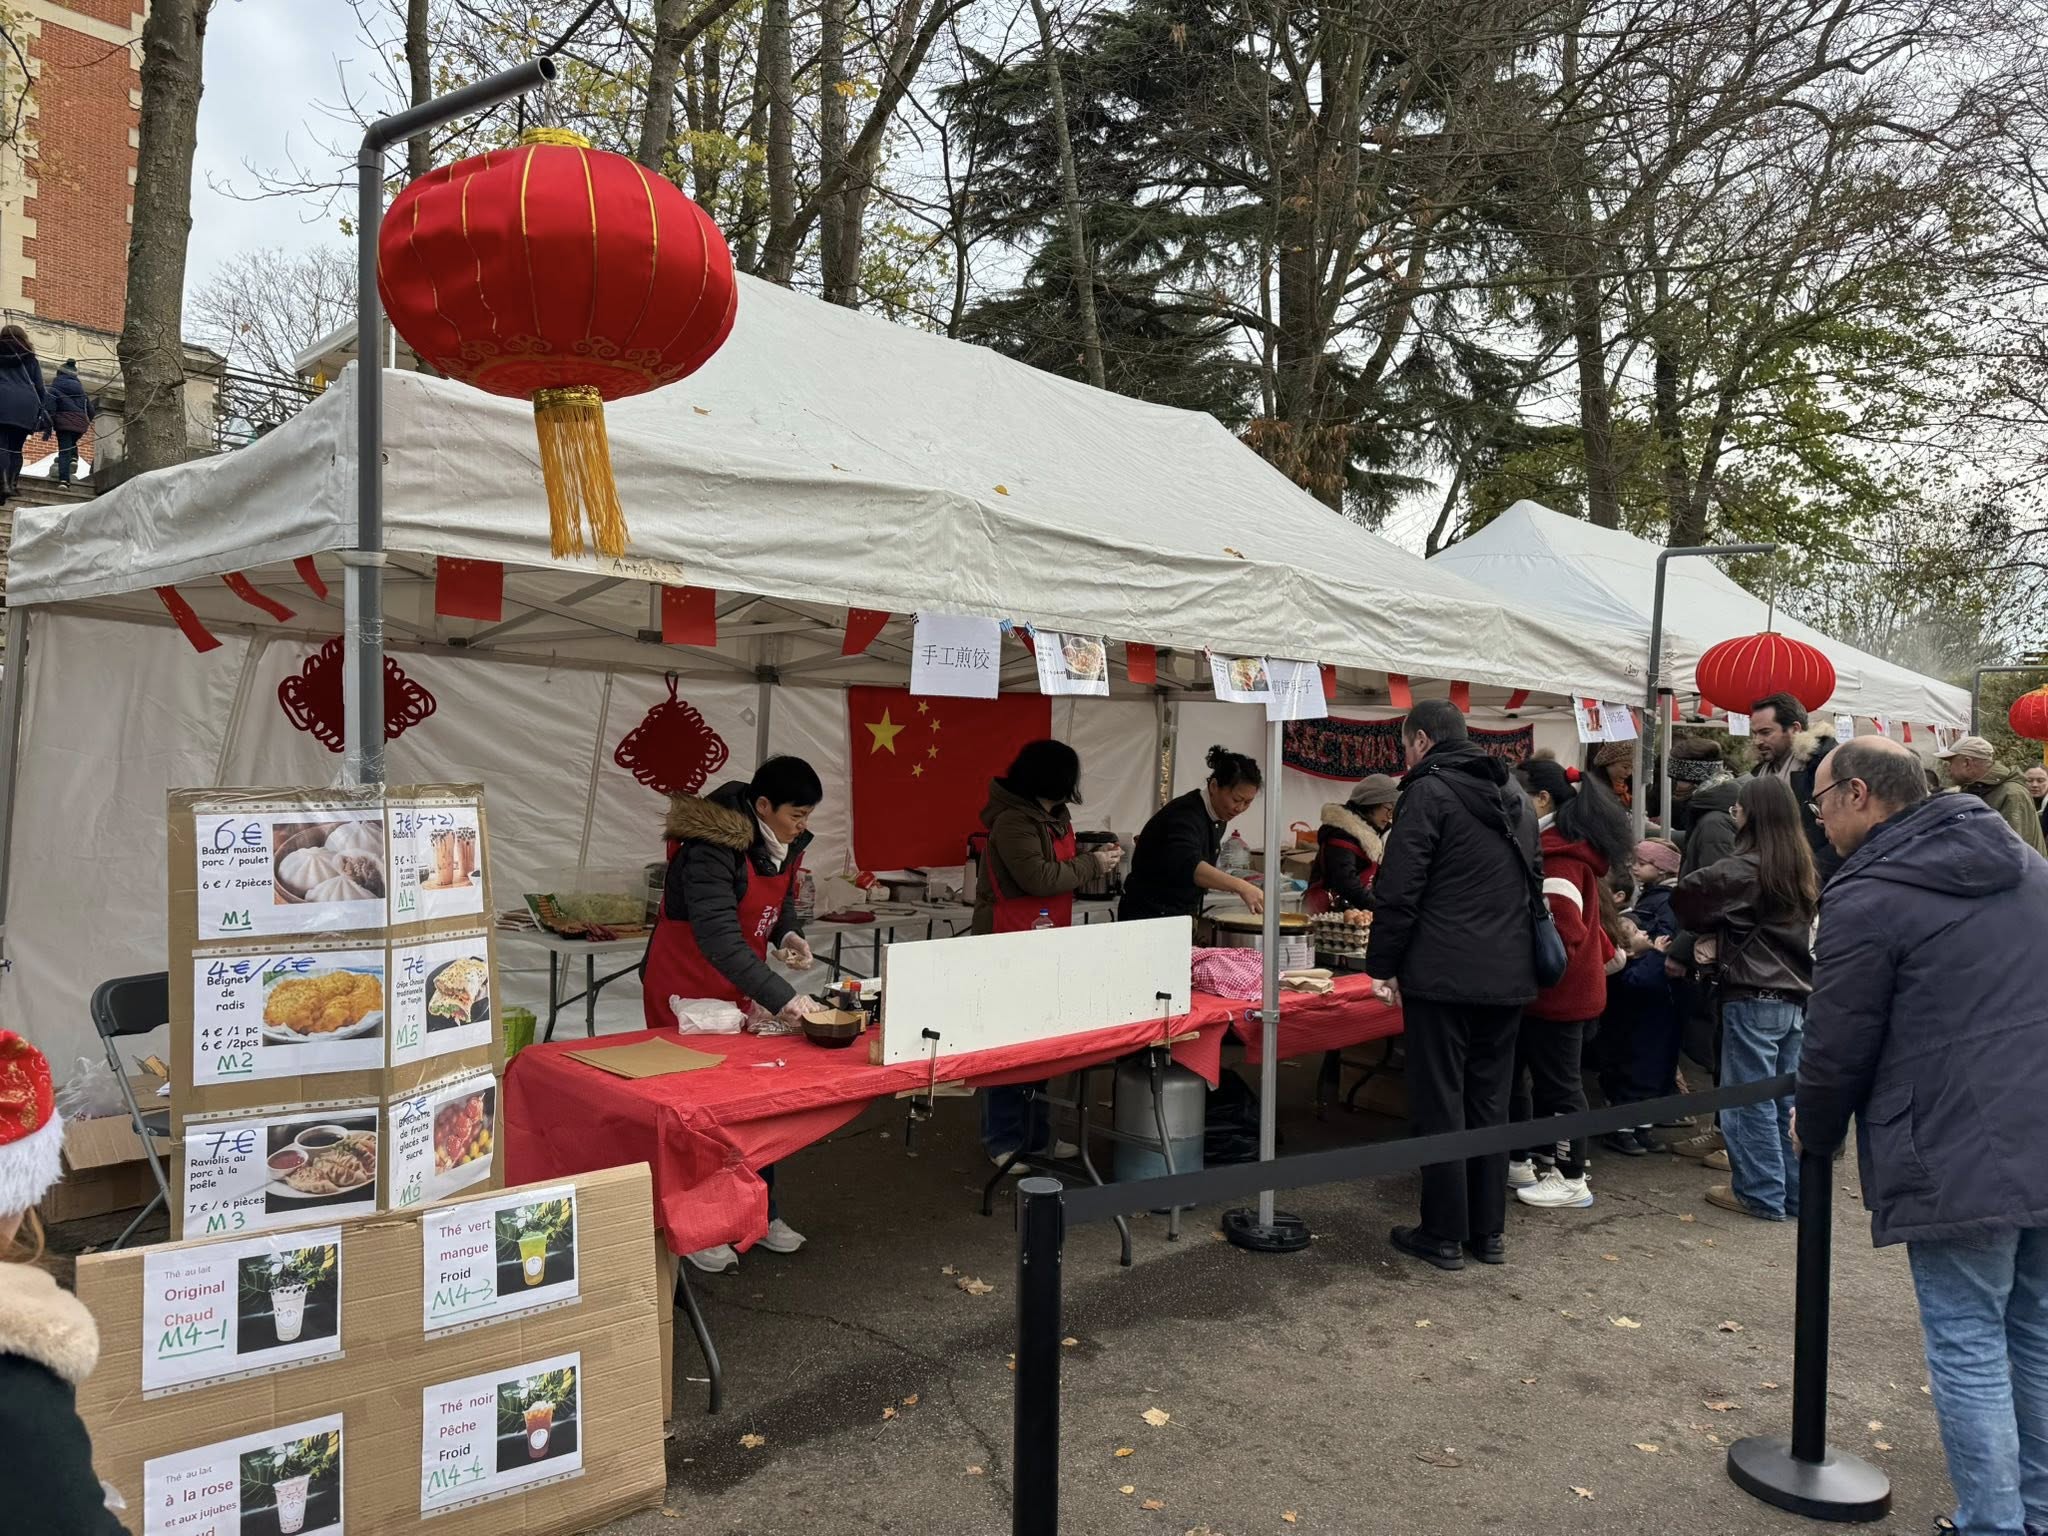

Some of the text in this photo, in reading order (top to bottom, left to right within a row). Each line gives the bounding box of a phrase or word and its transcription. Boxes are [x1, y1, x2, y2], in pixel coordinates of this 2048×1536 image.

[921, 644, 990, 670] 手工煎饺
[214, 819, 262, 850] 6€
[202, 846, 267, 855] Baozi maison
[202, 859, 225, 867] porc
[239, 857, 269, 867] poulet
[203, 881, 209, 889] 6
[213, 880, 221, 888] €
[235, 879, 272, 890] 2pièces
[398, 890, 415, 908] M4
[222, 910, 252, 926] M1
[402, 955, 424, 980] 7€
[207, 975, 250, 987] Beignet
[221, 988, 235, 998] de
[216, 1001, 245, 1011] radis
[202, 1029, 209, 1037] 4
[214, 1028, 222, 1036] €
[246, 1027, 258, 1037] pc
[397, 1024, 418, 1045] M5
[201, 1042, 208, 1051] 6
[214, 1041, 222, 1049] €
[217, 1052, 252, 1071] M2
[400, 1123, 429, 1139] de fruits
[206, 1130, 256, 1158] 7€
[400, 1137, 419, 1154] glacés
[191, 1154, 246, 1167] Raviolis au
[406, 1149, 423, 1160] sucre
[190, 1170, 213, 1180] porc
[218, 1168, 224, 1176] à
[410, 1171, 422, 1183] 2 €
[190, 1180, 217, 1192] poêle
[189, 1205, 196, 1213] 7
[200, 1203, 208, 1211] €
[222, 1200, 229, 1209] 6
[233, 1197, 265, 1209] pièces
[206, 1212, 245, 1233] M3
[439, 1219, 491, 1238] Thé vert
[440, 1242, 489, 1261] mangue
[164, 1270, 181, 1279] Thé
[198, 1266, 211, 1275] lait
[440, 1267, 471, 1284] Froid
[164, 1280, 225, 1301] Original
[432, 1278, 494, 1311] M4-3
[164, 1308, 214, 1327] Chaud
[158, 1319, 227, 1352] M4-1
[440, 1393, 494, 1415] Thé noir
[440, 1421, 477, 1438] Pêche
[439, 1443, 471, 1462] Froid
[166, 1466, 212, 1484] Thé au lait
[427, 1455, 483, 1492] M4-4
[165, 1480, 234, 1507] à la rose
[165, 1501, 237, 1528] et aux jujubes
